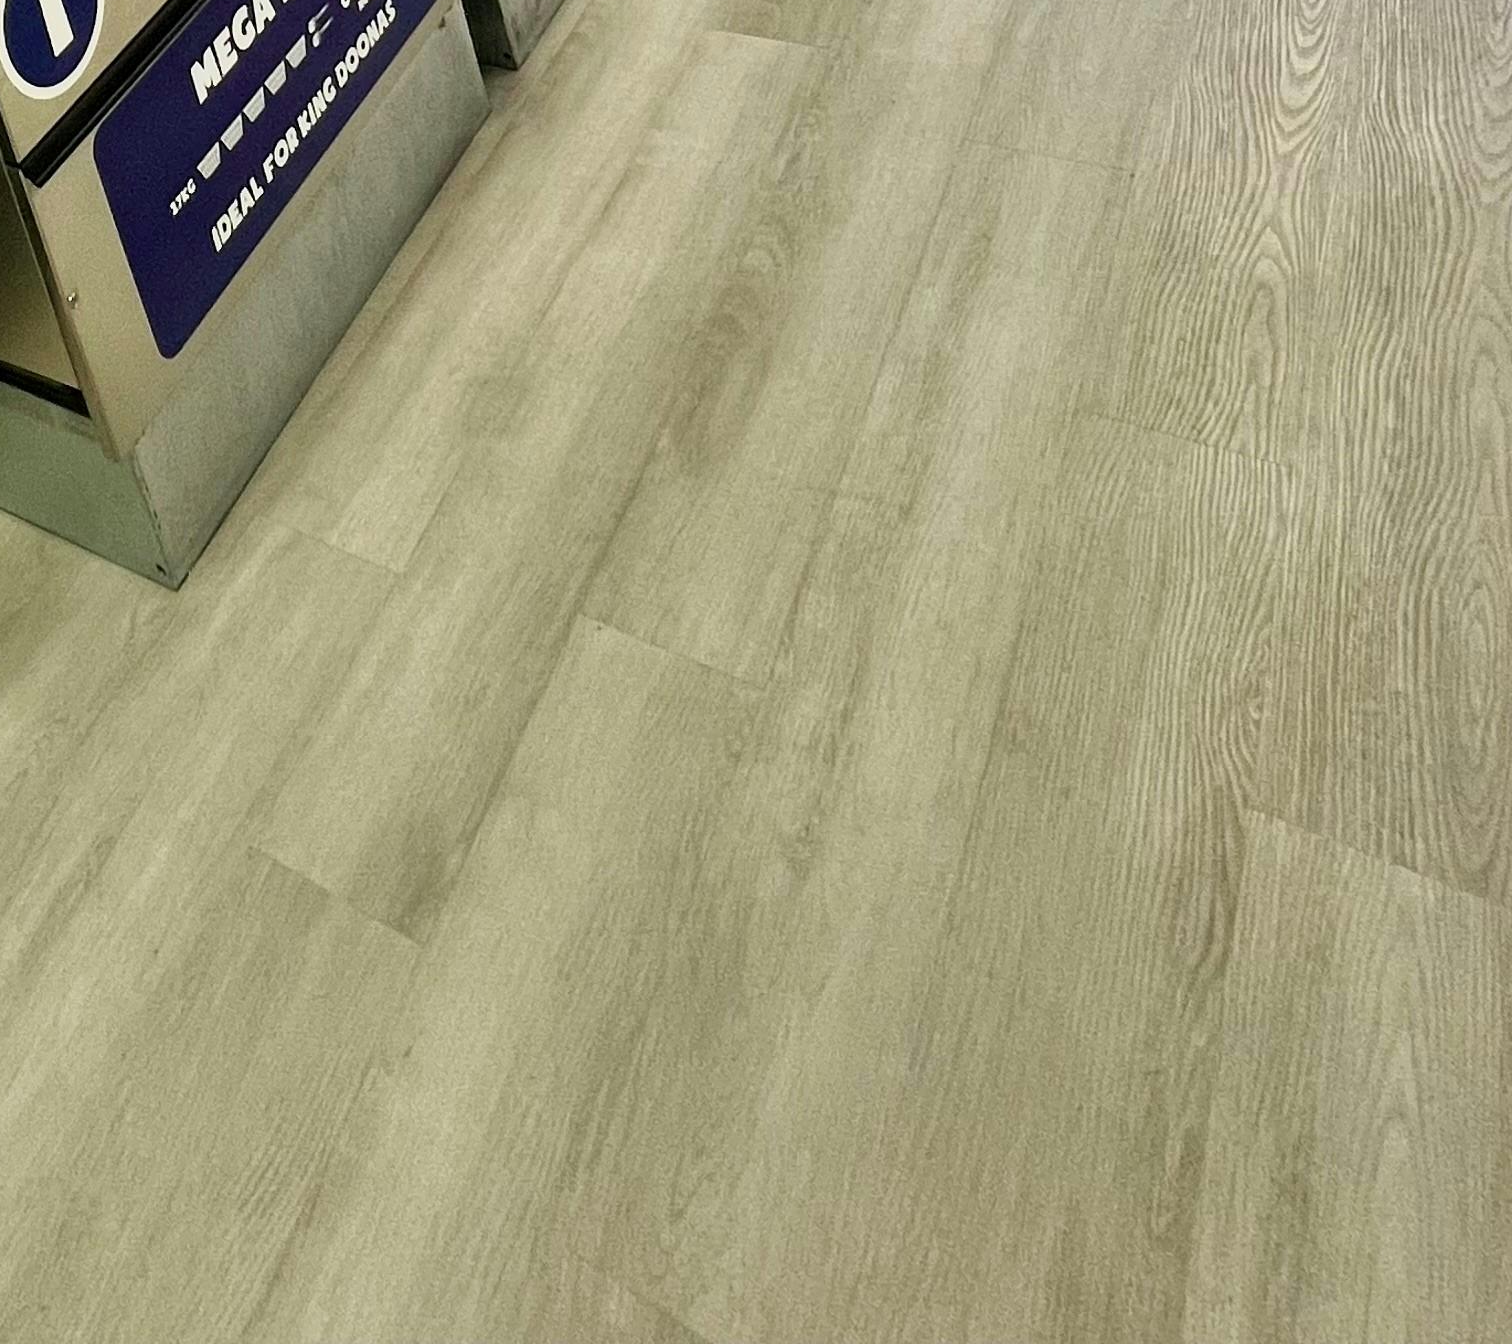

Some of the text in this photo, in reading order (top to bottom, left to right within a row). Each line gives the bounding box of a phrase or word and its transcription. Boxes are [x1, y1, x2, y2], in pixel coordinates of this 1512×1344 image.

[211, 176, 265, 253] IDEAL
[262, 126, 299, 184] FOR
[297, 76, 337, 138] KING
